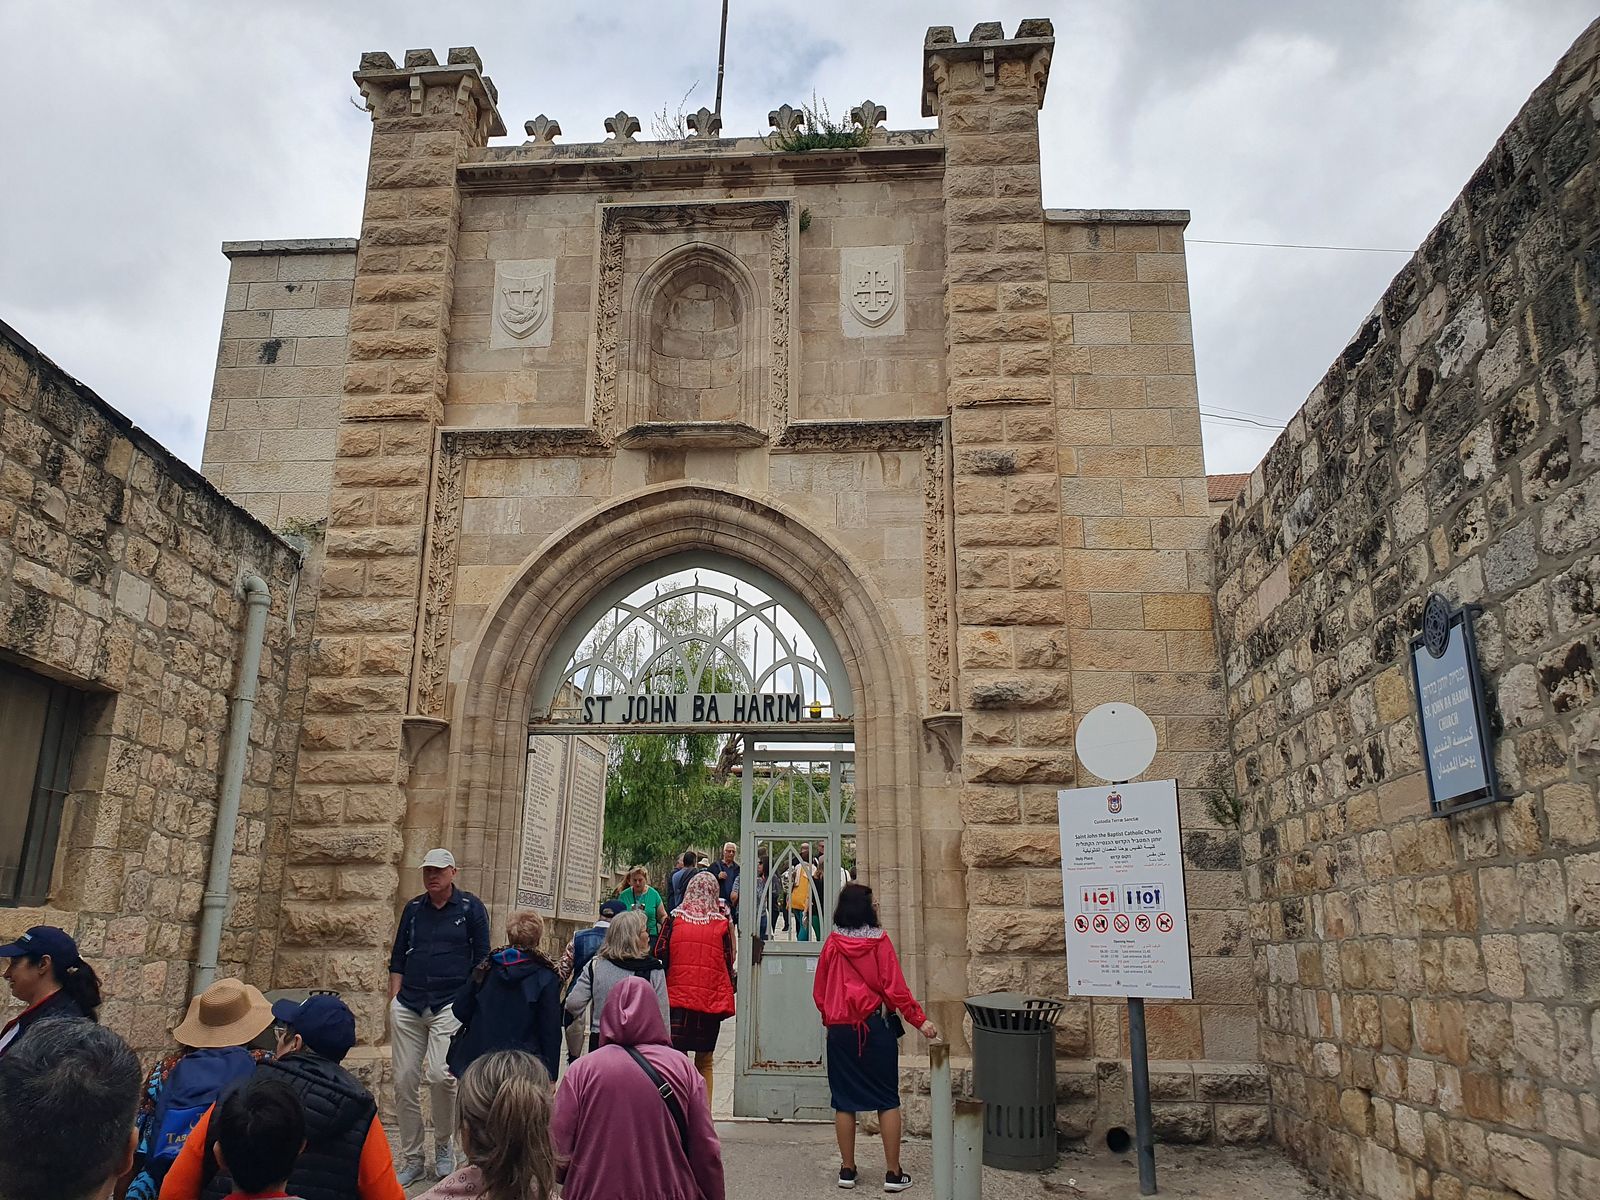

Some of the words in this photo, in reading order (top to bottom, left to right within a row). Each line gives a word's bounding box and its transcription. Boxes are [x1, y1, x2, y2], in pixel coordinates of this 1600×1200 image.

[584, 696, 612, 722] ST
[622, 696, 676, 723] JOHN
[693, 695, 718, 722] BA
[734, 694, 800, 722] HARIM
[1431, 699, 1444, 717] JOHN
[1439, 712, 1458, 731] CHURCH
